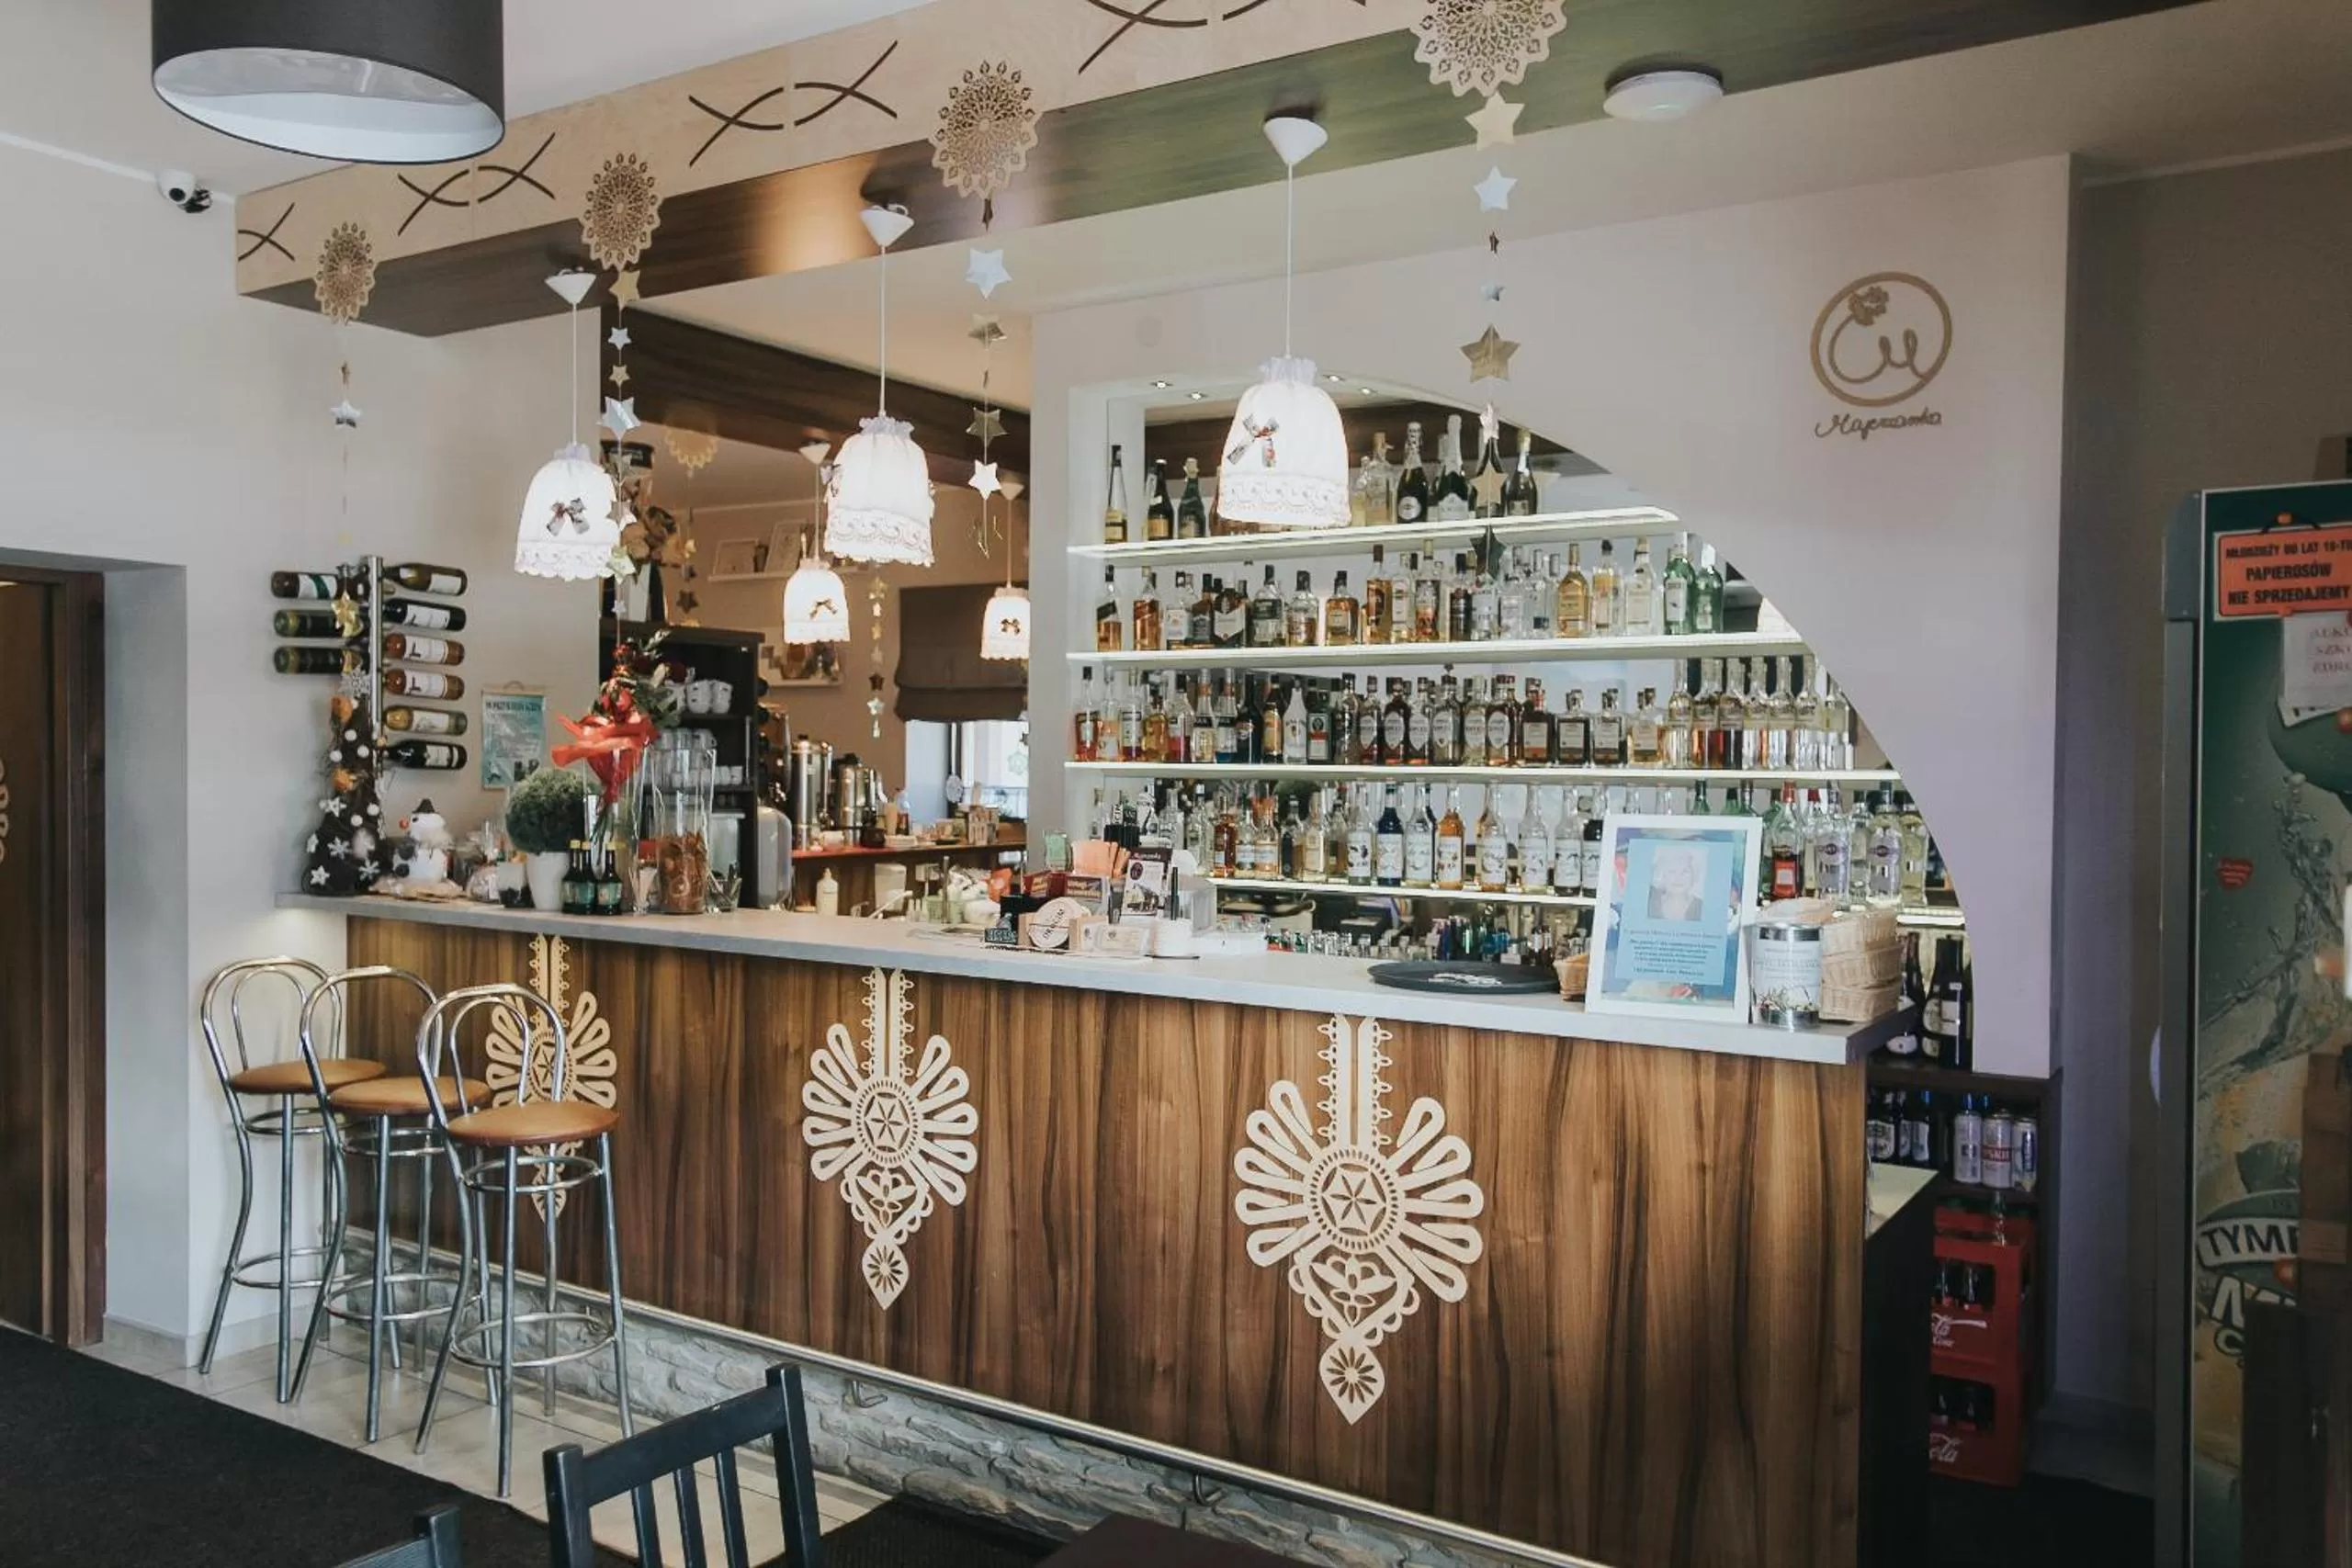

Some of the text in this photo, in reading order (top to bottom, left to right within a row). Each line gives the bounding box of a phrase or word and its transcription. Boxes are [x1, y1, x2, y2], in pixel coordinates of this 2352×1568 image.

[2301, 541, 2319, 555] LAT
[2245, 558, 2333, 581] PAPIEROSÓW
[2228, 585, 2351, 605] NIE SPRZEDAJEMY
